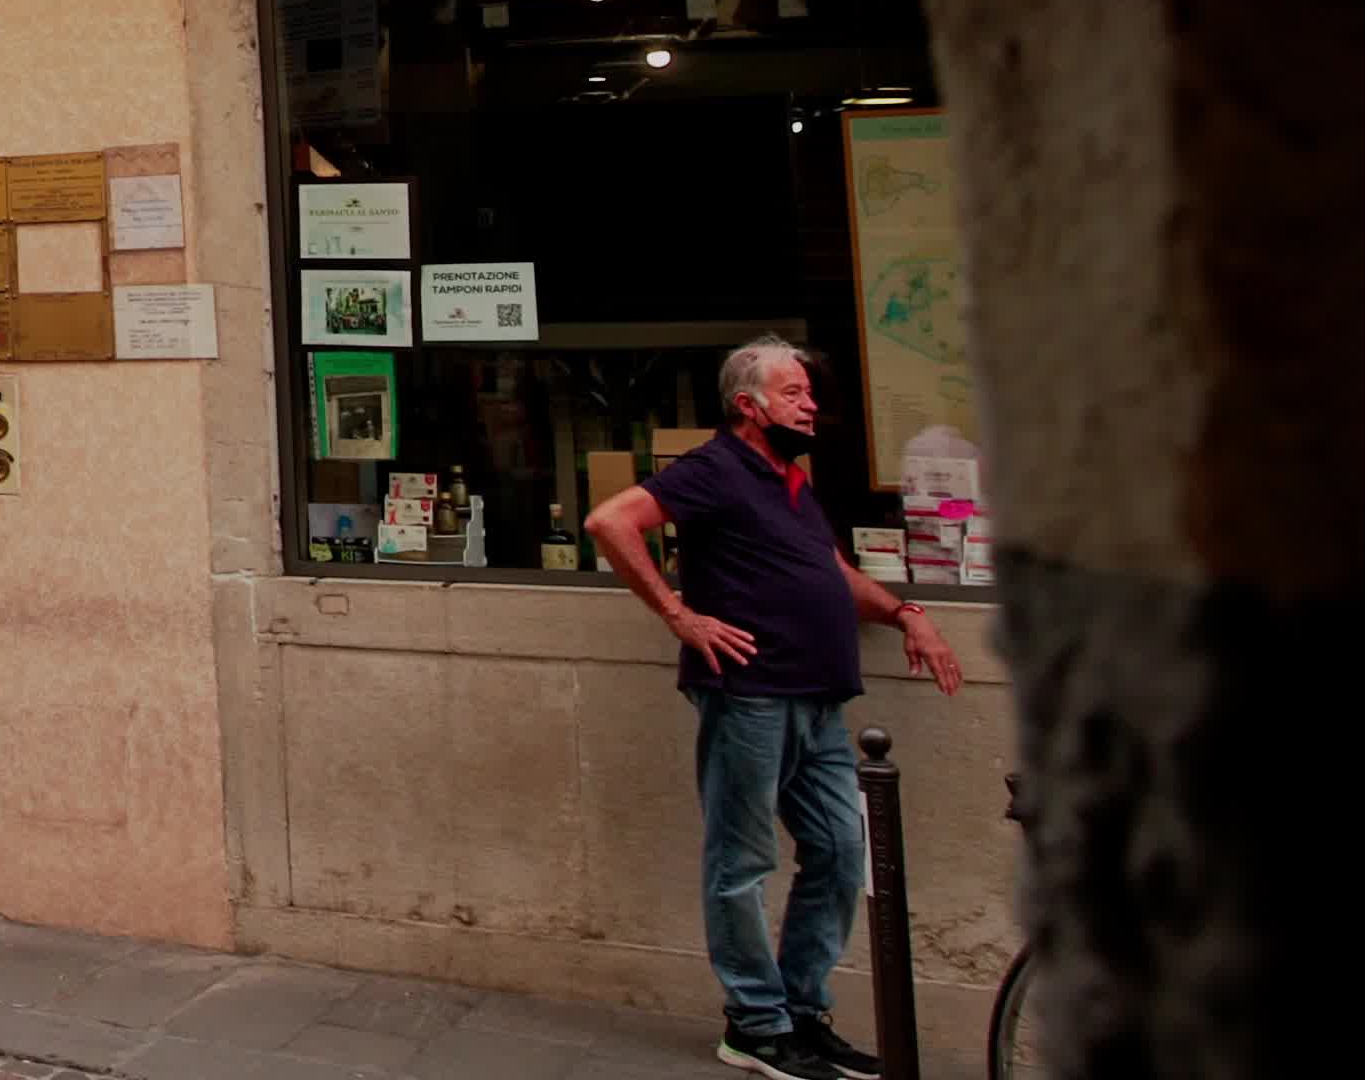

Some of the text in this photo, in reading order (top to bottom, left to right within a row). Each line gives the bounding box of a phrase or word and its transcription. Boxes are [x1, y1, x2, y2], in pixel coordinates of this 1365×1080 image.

[433, 271, 521, 282] PRENOTAZIONE
[432, 284, 522, 295] TAMPONI RAPIDI
